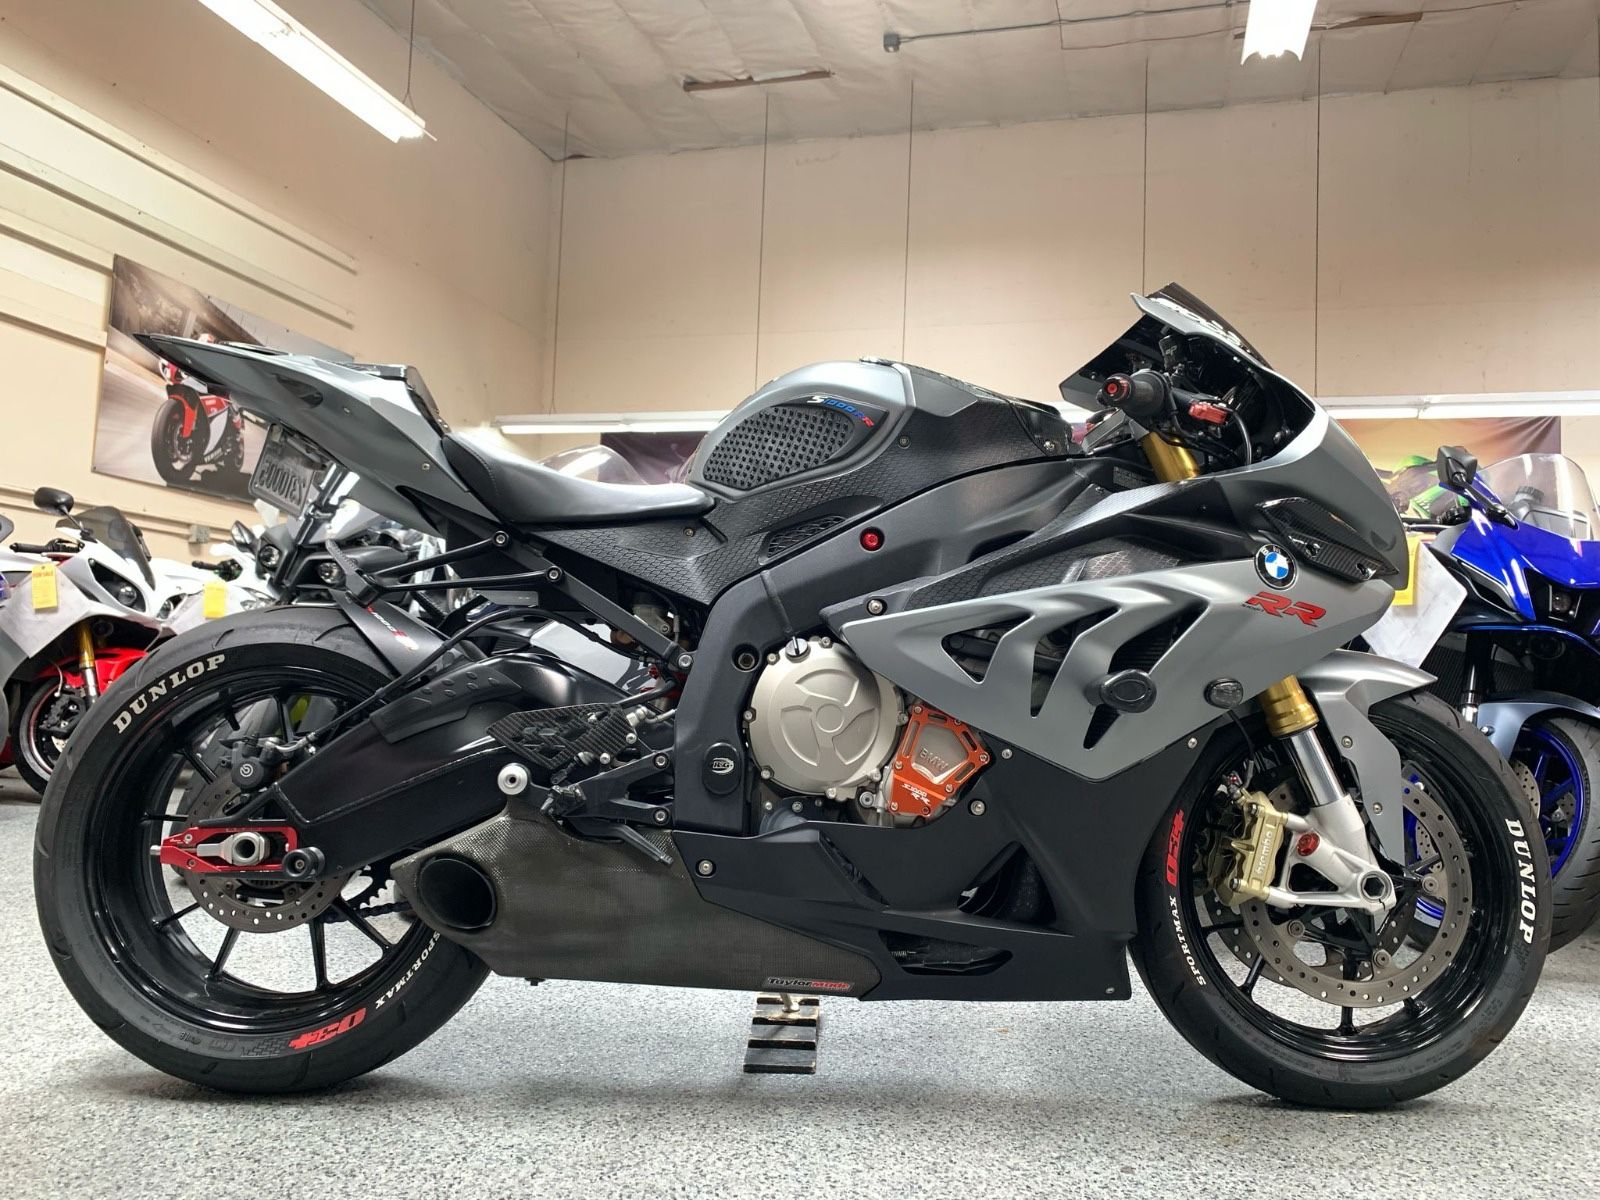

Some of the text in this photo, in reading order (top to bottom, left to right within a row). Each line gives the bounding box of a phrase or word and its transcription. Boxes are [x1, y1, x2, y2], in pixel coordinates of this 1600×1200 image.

[1245, 591, 1326, 627] RR
[113, 654, 225, 734] DUNLOP
[919, 747, 949, 769] BMW
[1255, 831, 1273, 875] brembo
[1505, 818, 1537, 944] DUNLOP
[375, 930, 441, 1010] SPORTMAX
[1169, 895, 1207, 987] SPORTMAX
